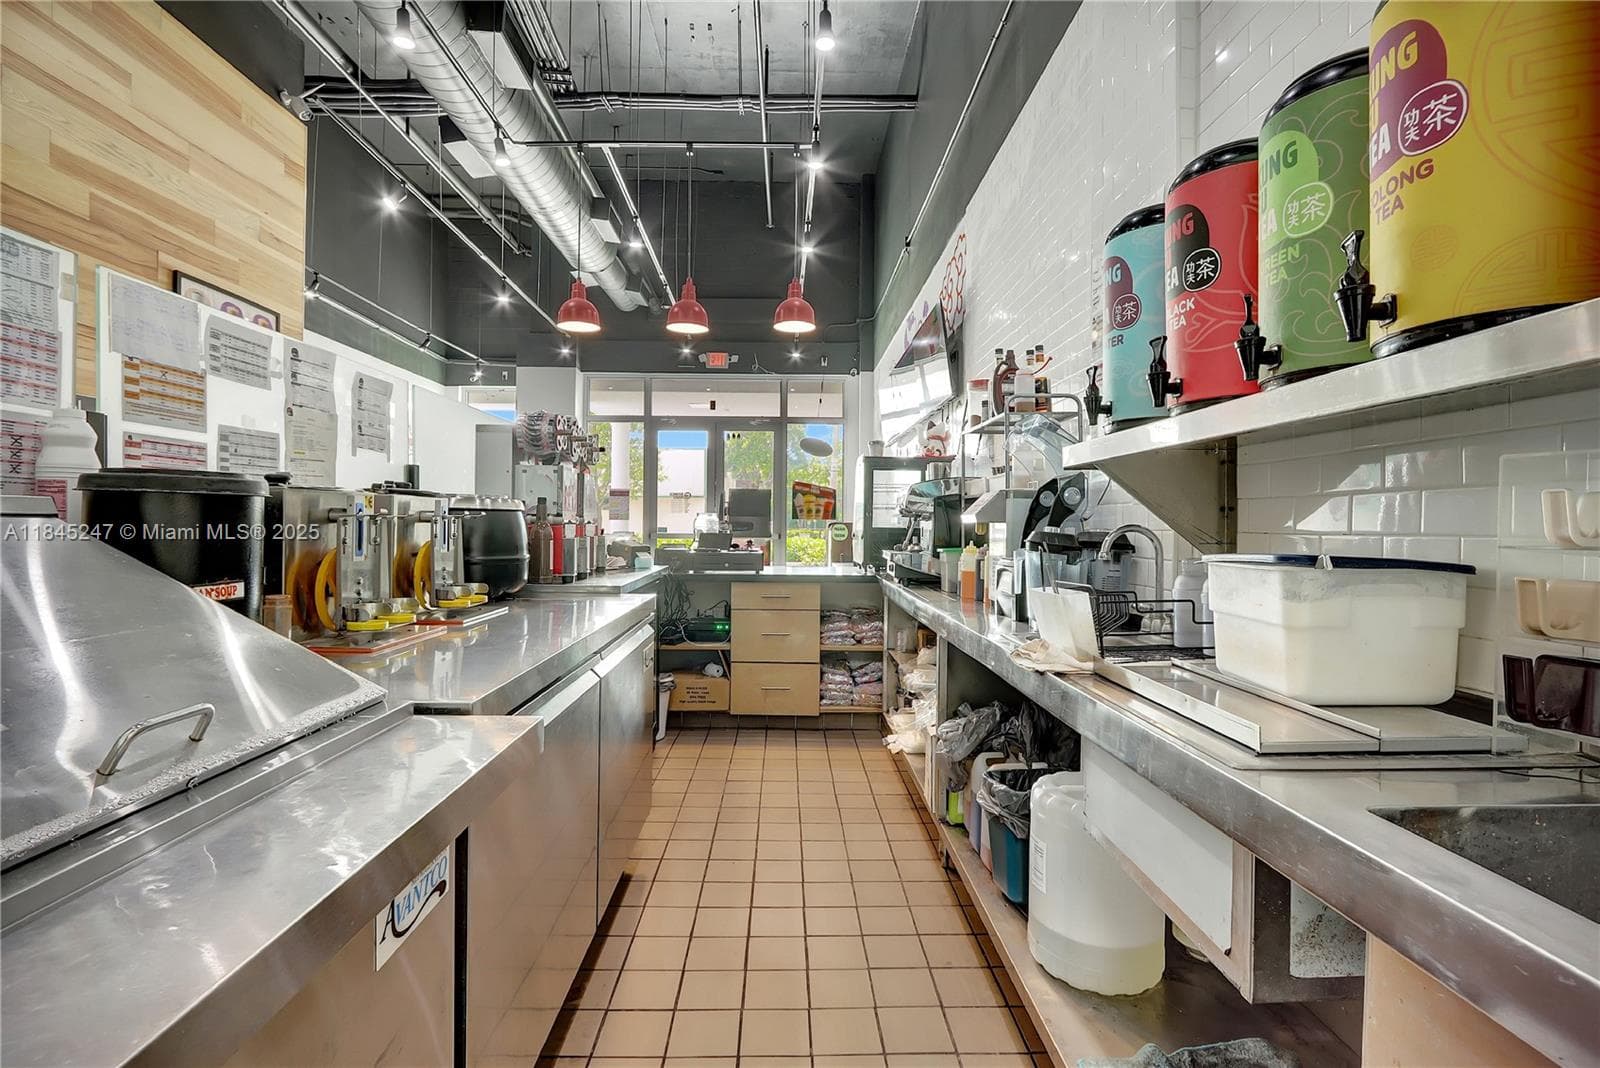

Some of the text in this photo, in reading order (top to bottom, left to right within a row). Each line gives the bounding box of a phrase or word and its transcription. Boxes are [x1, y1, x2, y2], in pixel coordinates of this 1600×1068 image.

[1369, 31, 1418, 101] UNG
[1369, 122, 1392, 168] EA
[1261, 140, 1298, 187] UNG
[1371, 158, 1434, 208] OLONG
[1261, 207, 1278, 240] EA
[1375, 194, 1405, 225] TEA
[1264, 243, 1300, 273] REEN
[1104, 263, 1122, 287] NG
[1165, 265, 1179, 292] EA
[1265, 266, 1288, 289] TEA
[1166, 297, 1195, 319] LACK
